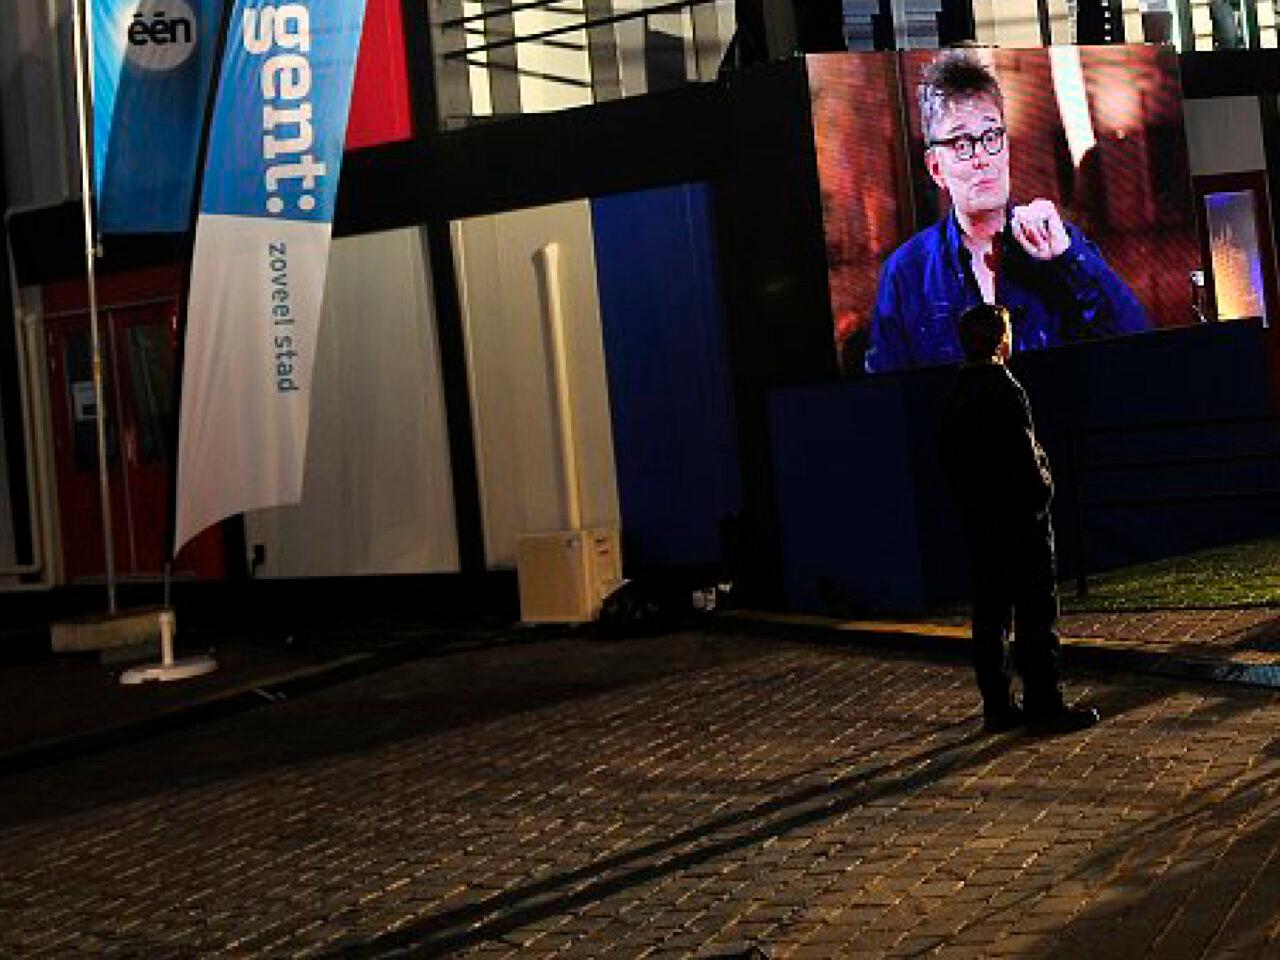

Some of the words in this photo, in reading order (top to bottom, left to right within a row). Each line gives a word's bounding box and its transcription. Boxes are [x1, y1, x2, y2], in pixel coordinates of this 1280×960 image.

[243, 3, 327, 214] gent:
[269, 242, 296, 327] zoveel
[274, 335, 300, 393] stad
